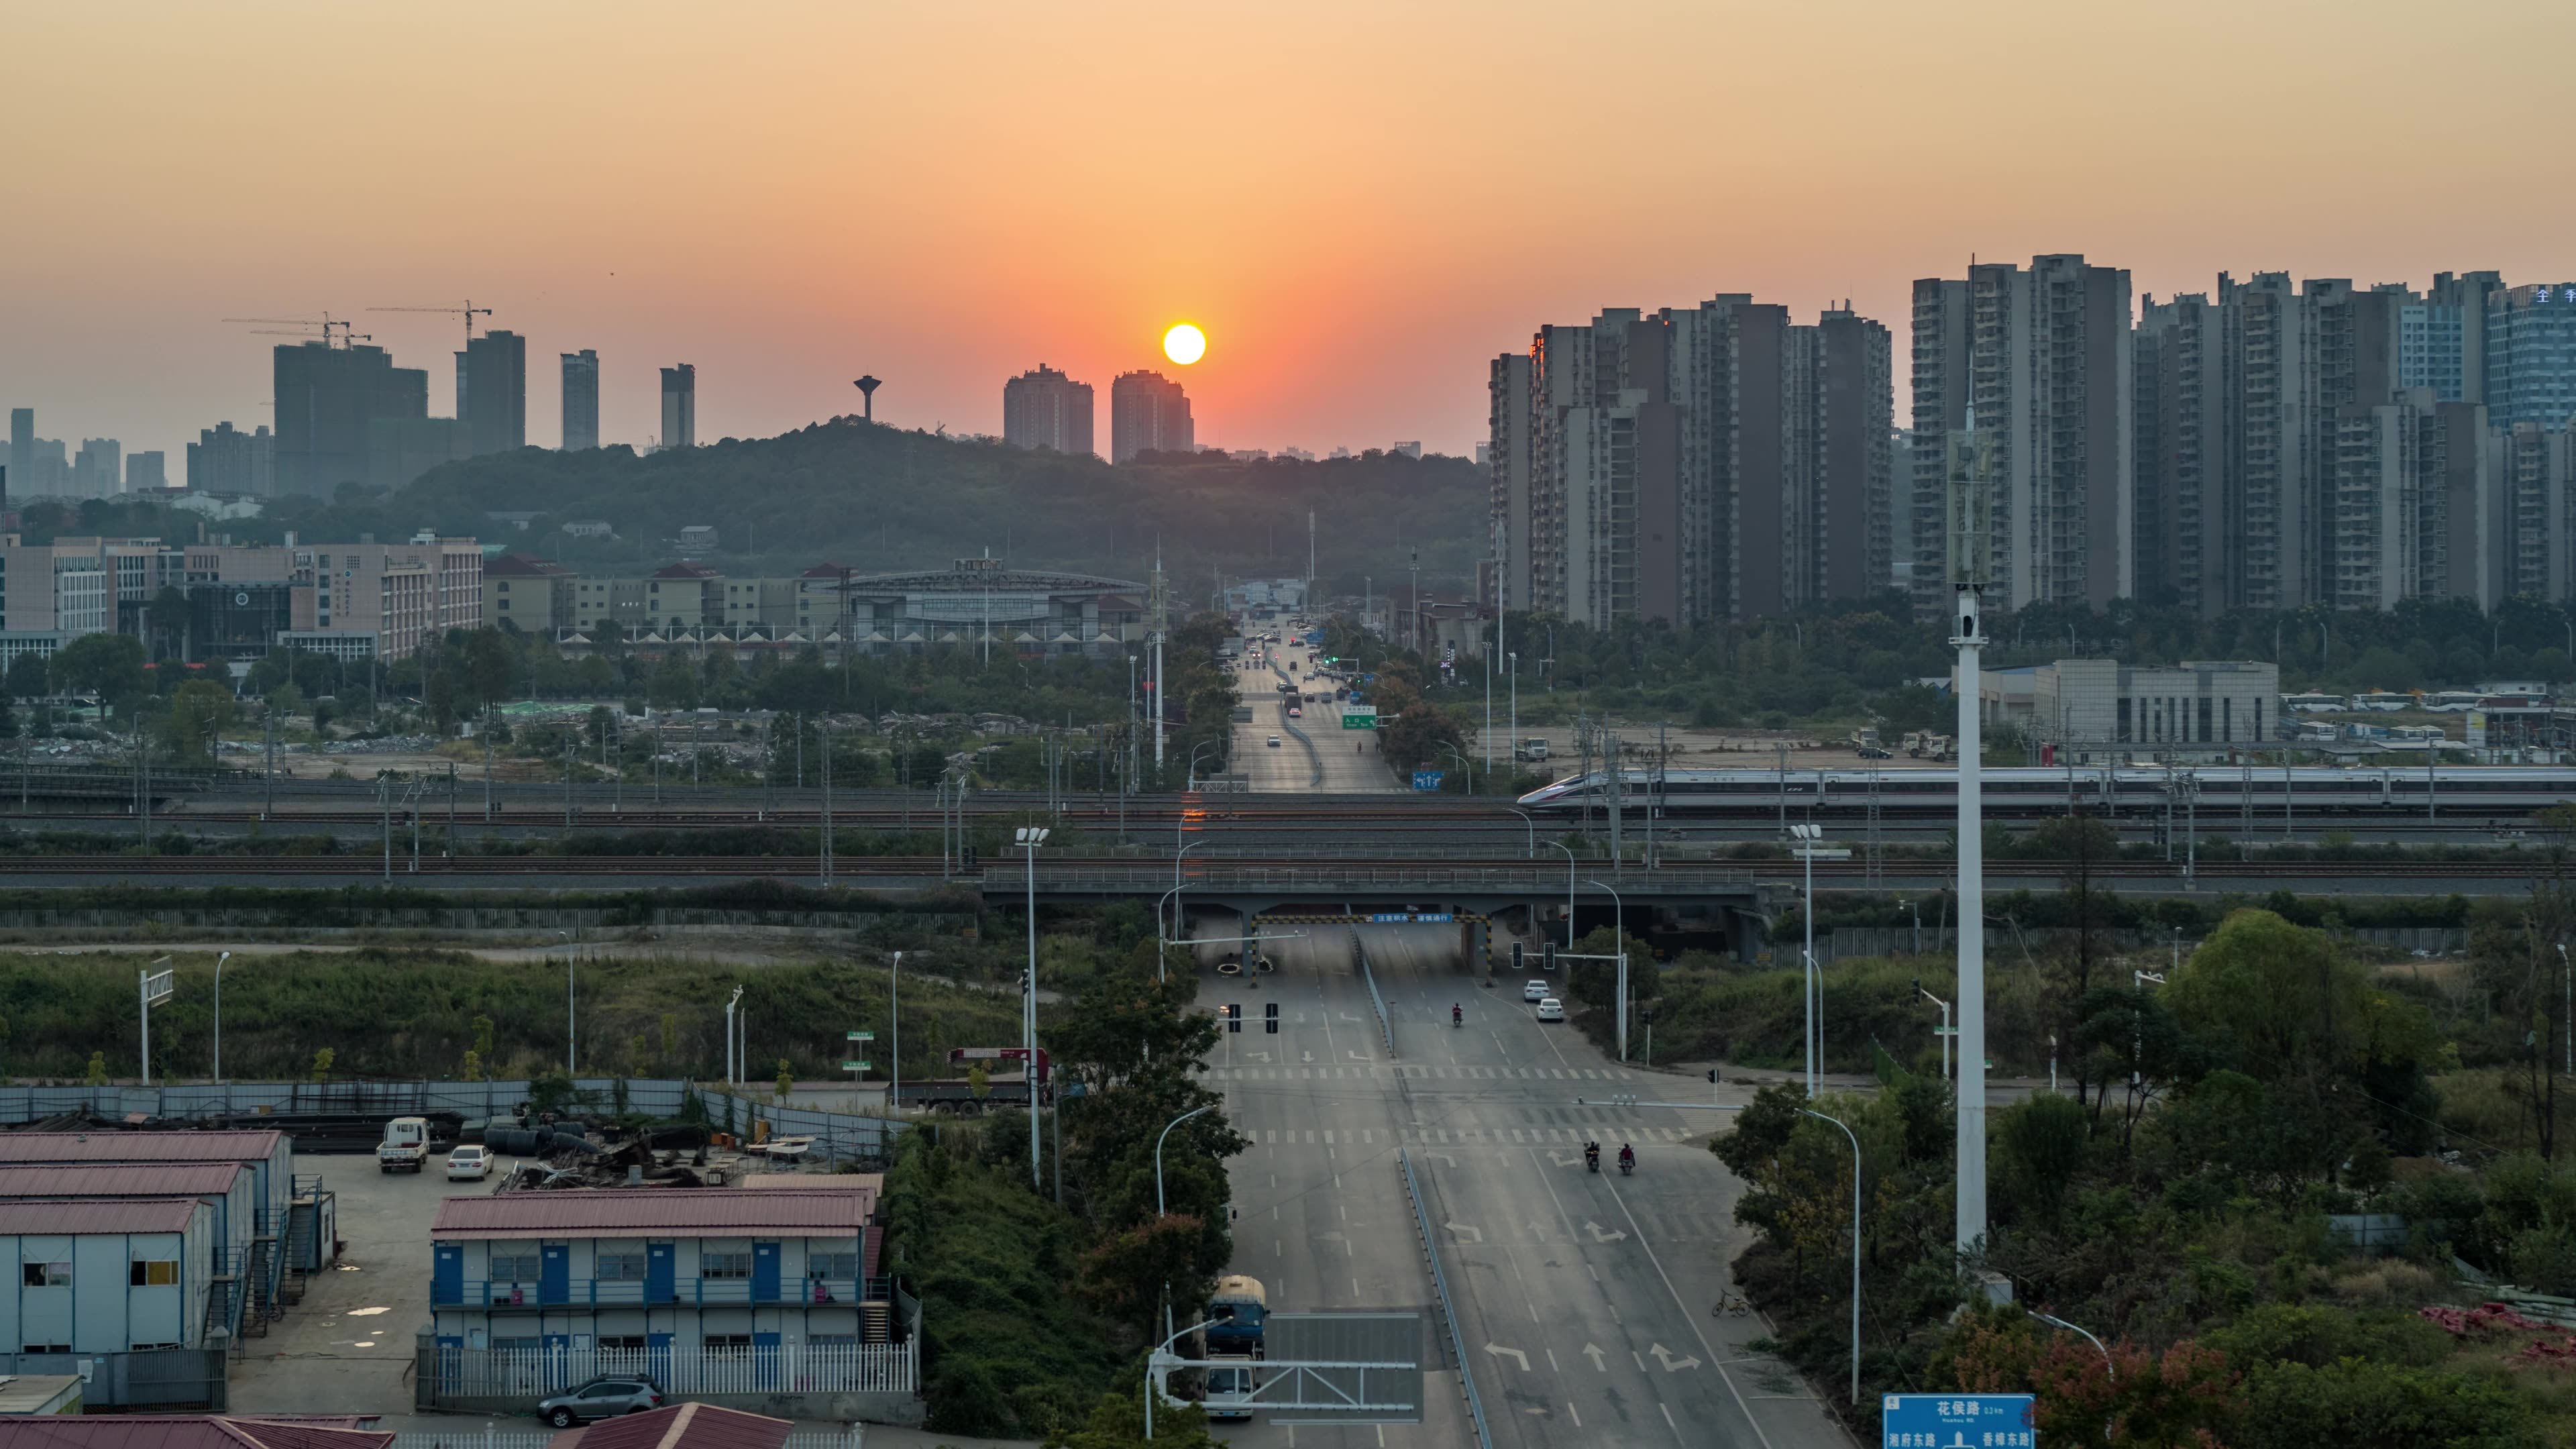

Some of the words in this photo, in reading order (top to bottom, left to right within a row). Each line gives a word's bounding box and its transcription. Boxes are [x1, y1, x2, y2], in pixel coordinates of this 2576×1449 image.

[2536, 289, 2576, 303] 全季
[1937, 1401, 1980, 1416] 花侯路
[1888, 1433, 1935, 1448] 湘府东路
[1983, 1432, 2029, 1447] 香樟东路
